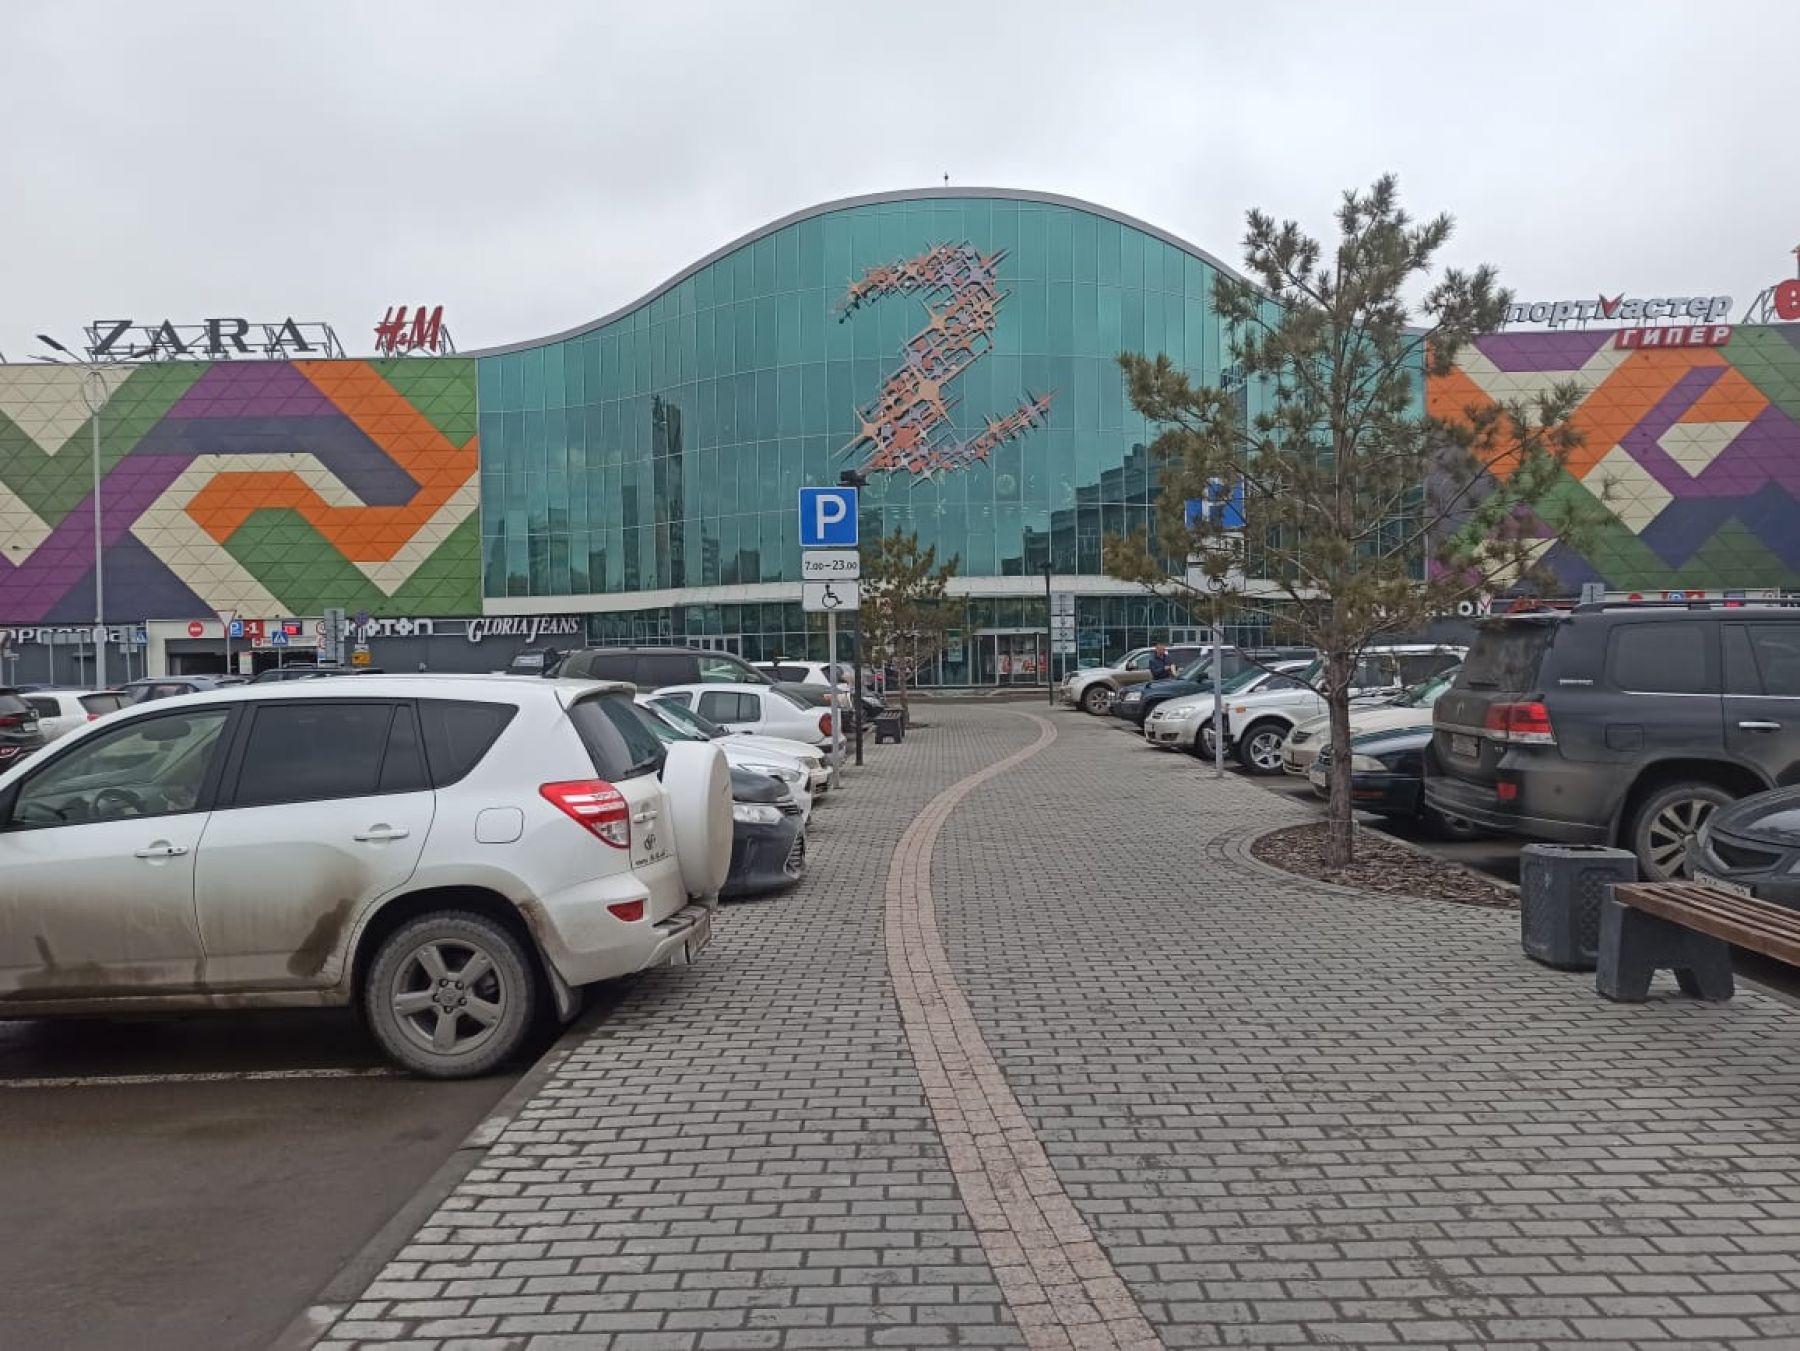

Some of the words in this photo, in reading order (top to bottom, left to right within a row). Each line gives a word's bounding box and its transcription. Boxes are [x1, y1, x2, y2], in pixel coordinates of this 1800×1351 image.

[374, 305, 443, 351] H&M
[1503, 292, 1733, 327] портмастер
[92, 316, 318, 355] ZARA
[1621, 327, 1730, 346] ГИПЕР
[815, 494, 847, 539] P
[464, 617, 528, 642] GLORIA
[525, 617, 580, 643] JEANS
